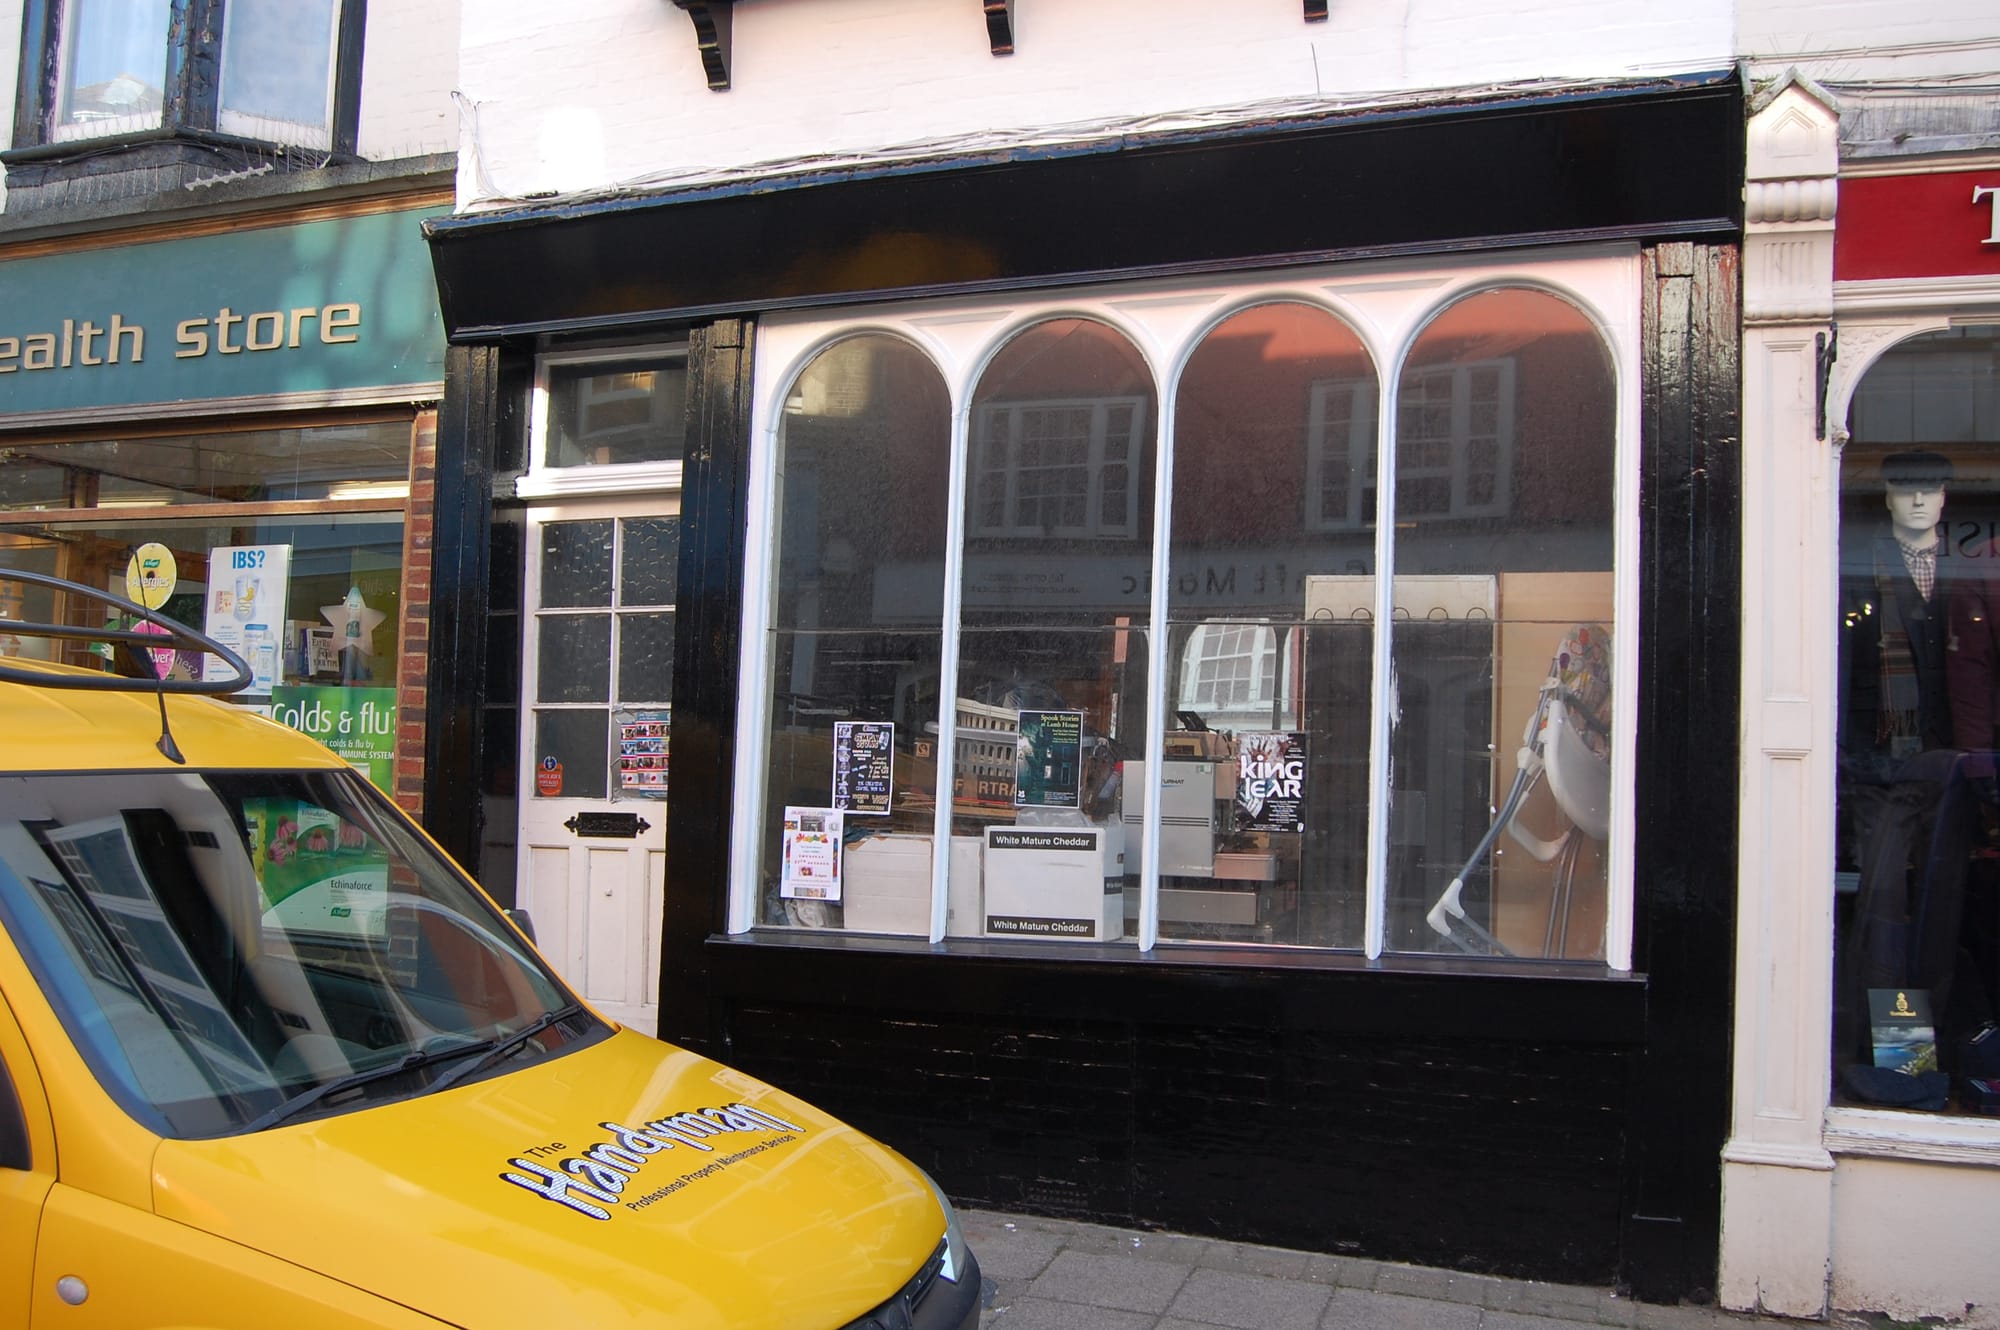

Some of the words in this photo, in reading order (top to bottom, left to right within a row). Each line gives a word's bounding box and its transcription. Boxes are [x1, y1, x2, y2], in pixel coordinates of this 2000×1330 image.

[175, 302, 361, 359] store
[232, 550, 266, 569] IBS?
[338, 710, 354, 734] &
[329, 739, 347, 748] colds
[369, 751, 395, 760] SYSTEM
[995, 836, 1020, 845] White
[1021, 836, 1051, 845] Mature
[1053, 837, 1090, 846] Cheddar
[330, 880, 372, 890] Echinaforce
[993, 920, 1018, 930] White
[1019, 921, 1049, 931] Mature
[1051, 922, 1088, 933] Cheddar
[523, 1140, 568, 1159] The
[498, 1102, 806, 1221] Handyman
[625, 1178, 688, 1212] Professional
[681, 1161, 725, 1184] Property
[715, 1140, 769, 1166] Maintenance
[767, 1134, 797, 1148] Services
